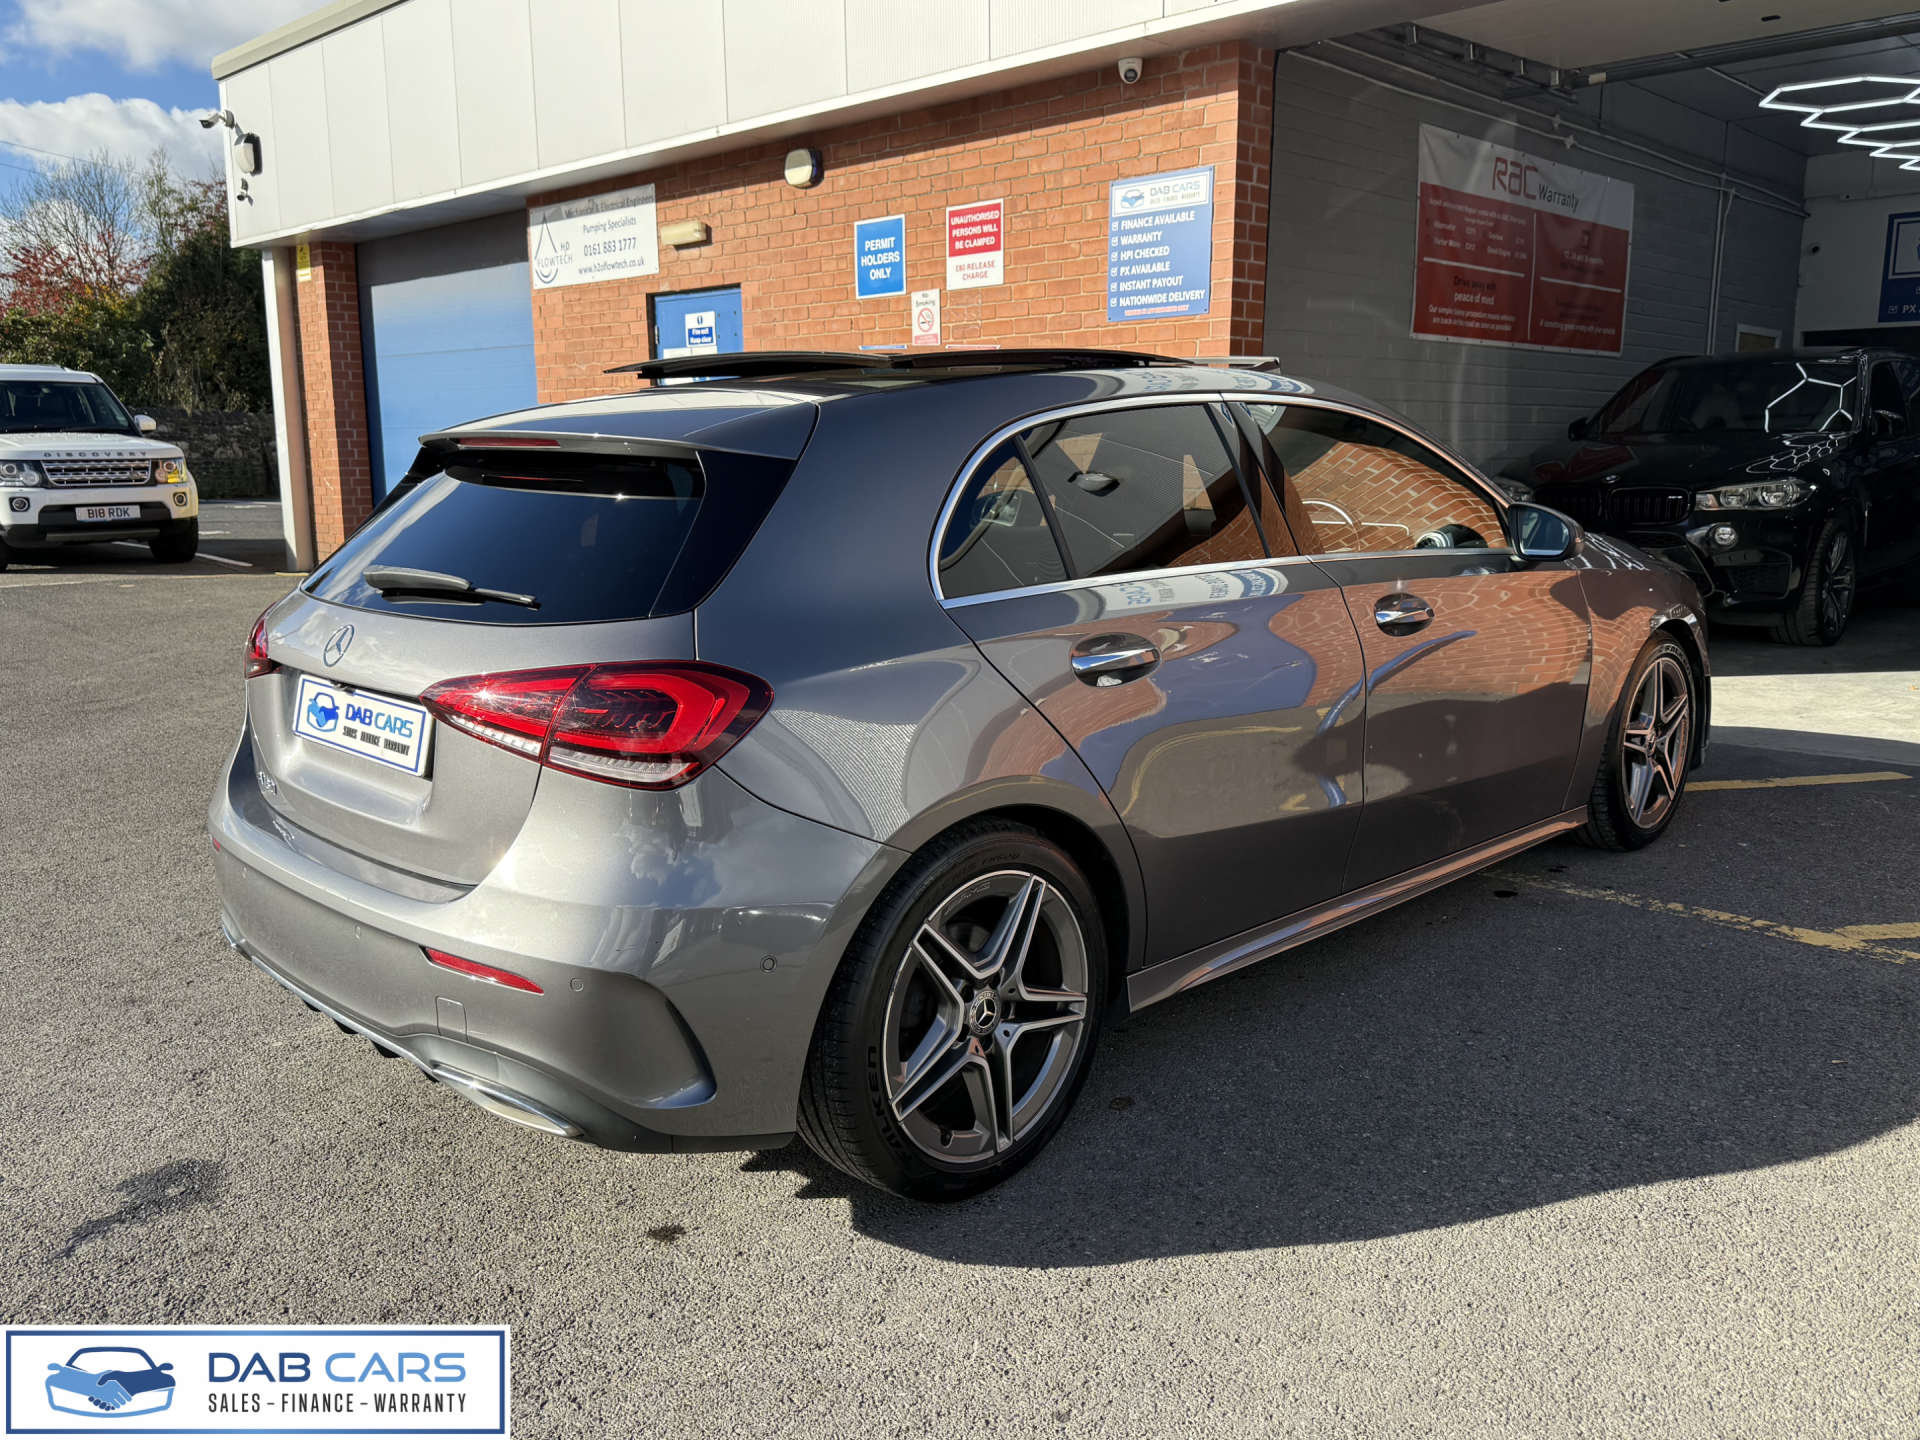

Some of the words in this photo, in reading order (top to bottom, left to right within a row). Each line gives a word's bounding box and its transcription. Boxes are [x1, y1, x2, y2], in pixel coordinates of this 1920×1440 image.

[1150, 185, 1171, 197] DAB
[1172, 181, 1200, 193] CARS
[1538, 184, 1580, 213] Warranty
[951, 209, 1000, 225] UNAUTHORISED
[1121, 216, 1153, 231] FINANCE
[1154, 210, 1196, 226] AVAILABLE
[583, 223, 607, 235] Pumping
[608, 216, 637, 231] Specialists
[952, 226, 982, 238] PERSONS
[982, 224, 998, 234] WILL
[864, 237, 895, 251] PERMIT
[954, 240, 964, 250] BE
[964, 236, 996, 249] CLAMPED
[1120, 231, 1162, 246] WARRANTY
[584, 243, 601, 257] 0161
[602, 240, 617, 254] 883
[619, 237, 637, 251] 1777
[1120, 250, 1133, 261] HPI
[1134, 246, 1170, 260] CHECKED
[537, 254, 573, 269] FLOWTECH
[861, 251, 900, 267] HOLDERS
[967, 259, 995, 271] RELEASE
[869, 267, 892, 281] ONLY
[962, 270, 988, 280] CHARGE
[1119, 266, 1130, 277] PX
[1131, 261, 1171, 275] AVAILABLE
[1119, 278, 1151, 292] INSTANT
[1152, 275, 1183, 289] PAYOUT
[1119, 294, 1168, 307] NATIONWIDE
[1168, 289, 1206, 302] DELIVERY
[1902, 304, 1916, 313] PX
[87, 508, 106, 519] B18
[108, 506, 130, 518] RDK
[345, 703, 373, 727] DAB
[374, 712, 414, 739] CARS
